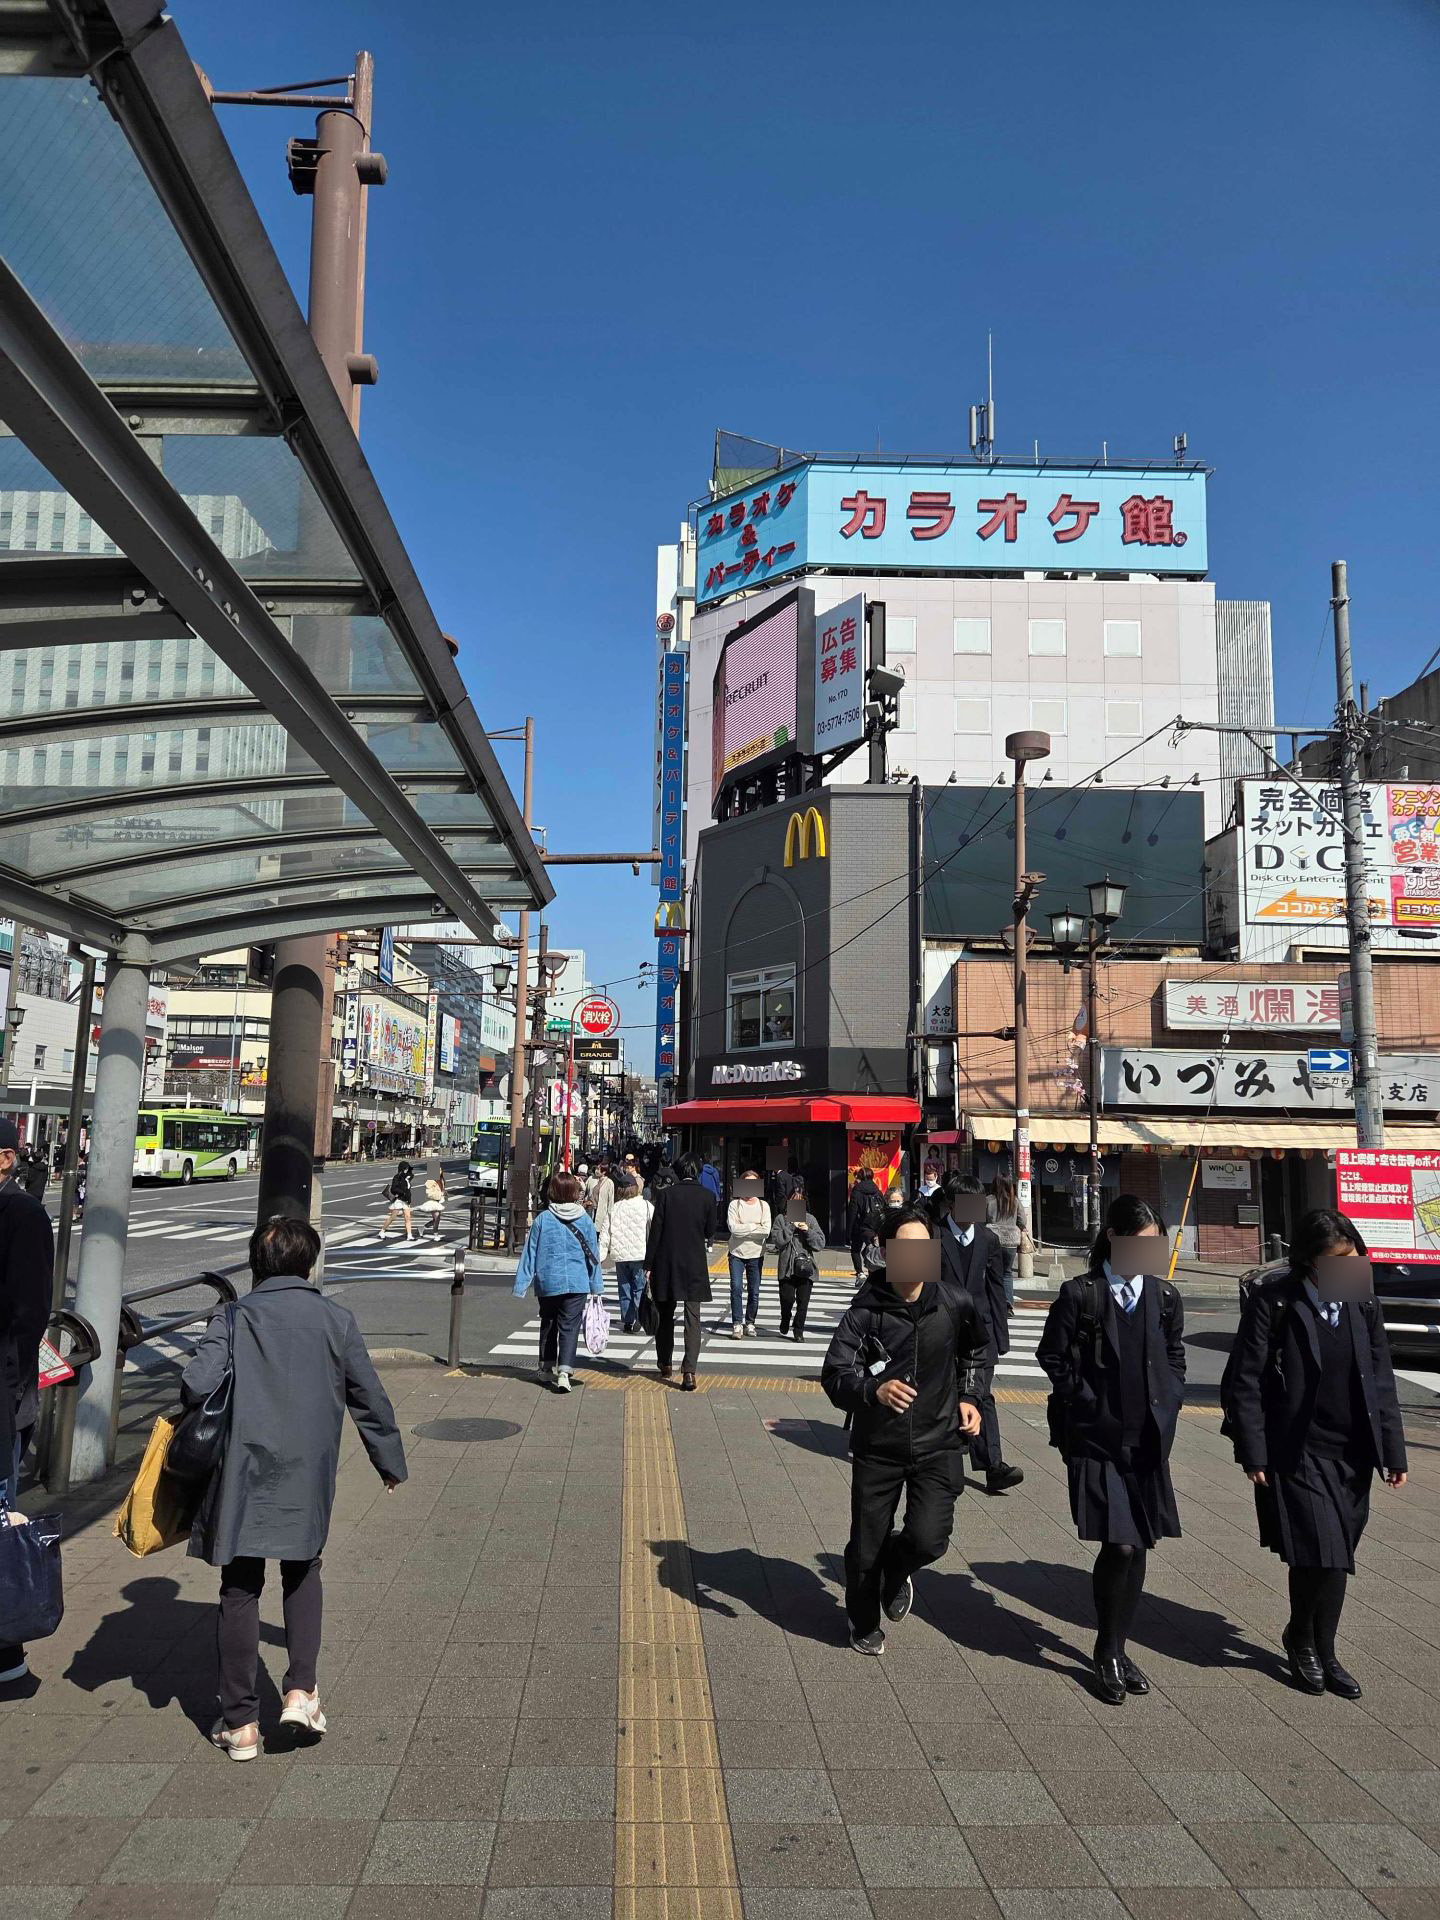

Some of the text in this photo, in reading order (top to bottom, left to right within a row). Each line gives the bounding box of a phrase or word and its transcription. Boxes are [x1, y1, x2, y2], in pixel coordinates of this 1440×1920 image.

[708, 482, 797, 536] カラオケ
[706, 541, 797, 588] パーティー
[821, 617, 857, 655] 広告
[820, 647, 857, 683] 募集
[725, 672, 769, 708] RECRUIT
[828, 688, 848, 704] No.170
[817, 707, 860, 735] 03-5774-7506
[1250, 816, 1383, 838] ネットカェ
[1275, 874, 1297, 883] City
[1299, 874, 1384, 884] Entertaent
[583, 1010, 611, 1024] 消火栓
[711, 1060, 803, 1084] McDonald's
[1312, 1076, 1350, 1086] ここから
[1345, 1082, 1428, 1102] 支店
[1340, 1171, 1364, 1181] ここは、
